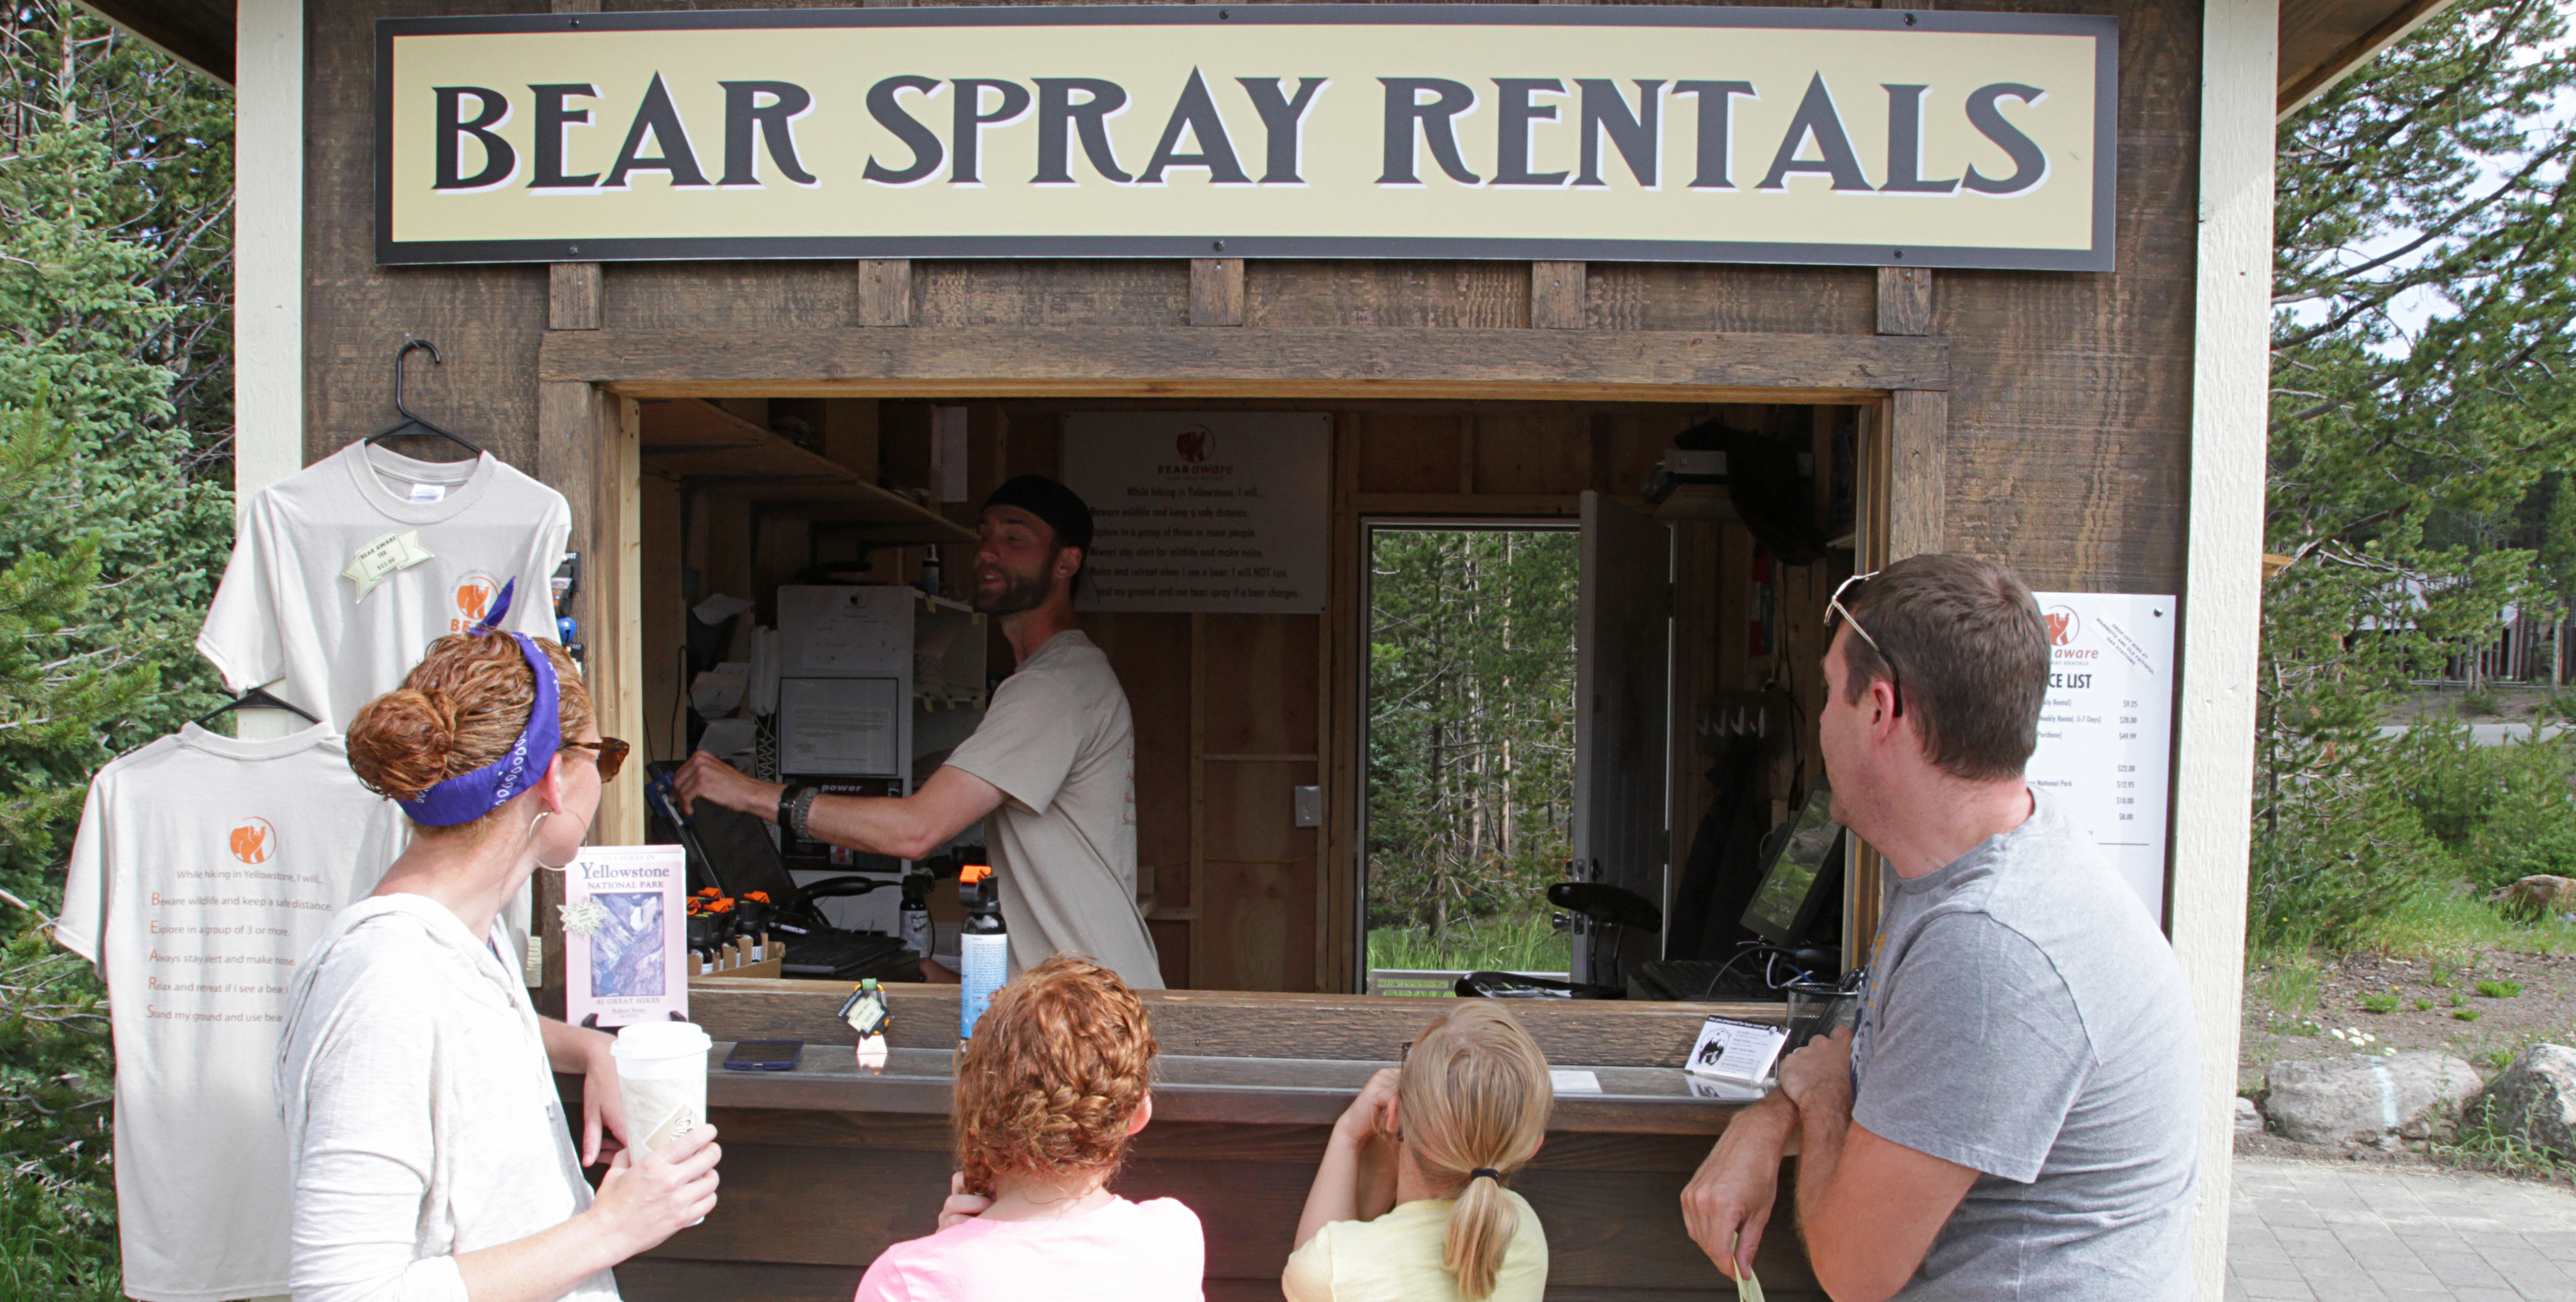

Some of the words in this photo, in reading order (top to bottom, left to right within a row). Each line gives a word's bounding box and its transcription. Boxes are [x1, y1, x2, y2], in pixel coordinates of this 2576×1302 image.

[431, 69, 821, 195] BEAR
[862, 64, 1332, 191] SPRAY
[1375, 69, 2052, 199] RENTALS
[1157, 465, 1188, 474] BEAR
[1192, 464, 1233, 475] aware
[1127, 486, 1149, 496] While
[1151, 487, 1175, 499] hiking
[1178, 487, 1185, 496] in
[1122, 507, 1150, 517] wildlife
[1153, 507, 1167, 517] and
[1170, 507, 1188, 519] keep
[1198, 507, 1213, 517] safe
[1121, 528, 1128, 536] in
[1138, 529, 1160, 539] group
[1163, 527, 1170, 536] of
[1173, 527, 1193, 536] three
[360, 548, 375, 559] BEAR
[376, 535, 396, 551] AWARE
[1089, 547, 1116, 558] Always
[1119, 548, 1133, 558] stay
[1135, 547, 1154, 557] alert
[1157, 546, 1167, 556] for
[1170, 547, 1198, 557] wildlife
[1200, 547, 1215, 557] and
[1218, 547, 1239, 557] make
[377, 550, 387, 558] TEE
[377, 557, 396, 570] $22.00
[1089, 566, 1111, 576] Relax
[1114, 567, 1129, 576] and
[1131, 568, 1157, 576] retreat
[1160, 568, 1179, 576] when
[1237, 568, 1251, 577] will
[1254, 568, 1271, 577] NOT
[450, 569, 477, 593] YELLOWSTONE
[480, 570, 502, 587] NATIONAL
[1128, 587, 1155, 598] ground
[1158, 586, 1173, 596] and
[1190, 586, 1207, 597] bear
[1210, 589, 1230, 599] spray
[1233, 586, 1238, 596] if
[1248, 587, 1266, 597] bear
[450, 618, 472, 633] BE
[2112, 624, 2132, 643] DROP-OFF
[2131, 643, 2143, 653] BINS
[2096, 617, 2118, 639] MAMMOTH
[2118, 638, 2127, 647] AND
[2126, 647, 2135, 655] OLD
[2135, 655, 2154, 675] FAITHFUL
[2106, 636, 2116, 646] GAS
[2116, 645, 2136, 666] STATIONS
[2054, 649, 2099, 659] aware
[2067, 674, 2093, 689] LIST
[2053, 699, 2071, 707] Rental)
[2057, 715, 2075, 723] Rental,
[2087, 716, 2101, 724] Days)
[2119, 716, 2137, 724] $28.00
[2119, 732, 2137, 740] $49.99
[2117, 780, 2135, 789] $12.95
[2116, 796, 2134, 804] $10.00
[2119, 813, 2134, 821] $8.00
[177, 870, 203, 878] While
[204, 870, 231, 880] hiking
[244, 870, 296, 882] Yellowstone,
[579, 862, 670, 879] Yellowstone
[640, 880, 665, 889] PARK
[152, 892, 185, 906] Beware
[188, 896, 219, 905] wildlife
[221, 896, 239, 905] and
[242, 897, 266, 907] keep
[276, 898, 291, 907] safe
[292, 900, 333, 911] distance.
[151, 920, 184, 935] Explore
[187, 925, 197, 933] in
[205, 926, 231, 936] group
[234, 925, 245, 933] of
[247, 926, 253, 934] 3
[268, 928, 290, 937] more.
[150, 949, 181, 965] Always
[184, 954, 204, 965] stay
[204, 954, 222, 963] alert
[225, 955, 244, 964] and
[247, 955, 273, 964] make
[275, 956, 297, 966] noise.
[149, 976, 172, 991] Relax
[174, 983, 193, 991] and
[197, 984, 222, 993] retreat
[225, 984, 232, 992] if
[239, 985, 256, 993] see
[147, 1004, 172, 1019] Stand
[175, 1013, 190, 1021] my
[192, 1013, 222, 1022] ground
[225, 1013, 244, 1022] and
[264, 1013, 283, 1022] bear
